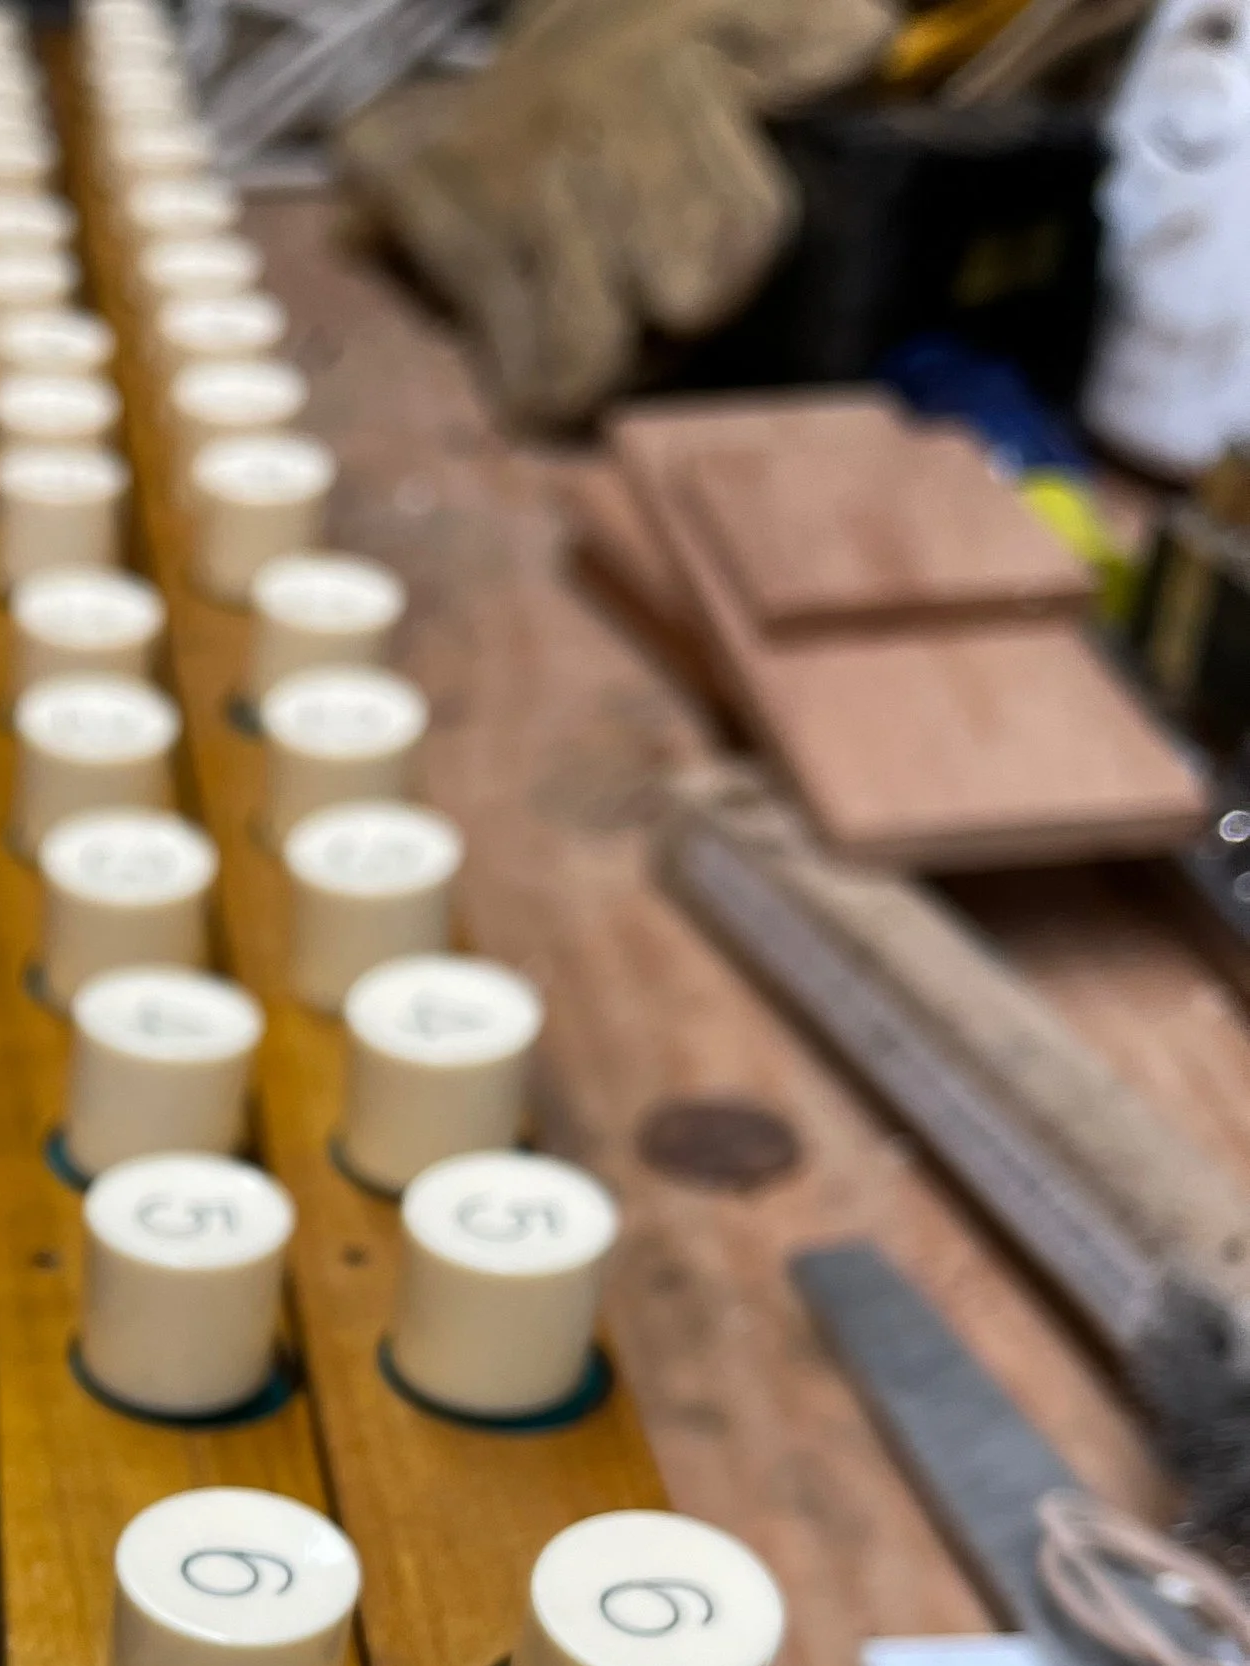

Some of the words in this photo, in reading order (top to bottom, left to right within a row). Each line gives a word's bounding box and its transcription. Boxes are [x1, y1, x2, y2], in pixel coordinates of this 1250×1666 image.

[135, 1197, 238, 1240] 5
[456, 1196, 561, 1241] 5
[180, 1548, 295, 1597] 6
[599, 1579, 715, 1638] 6
